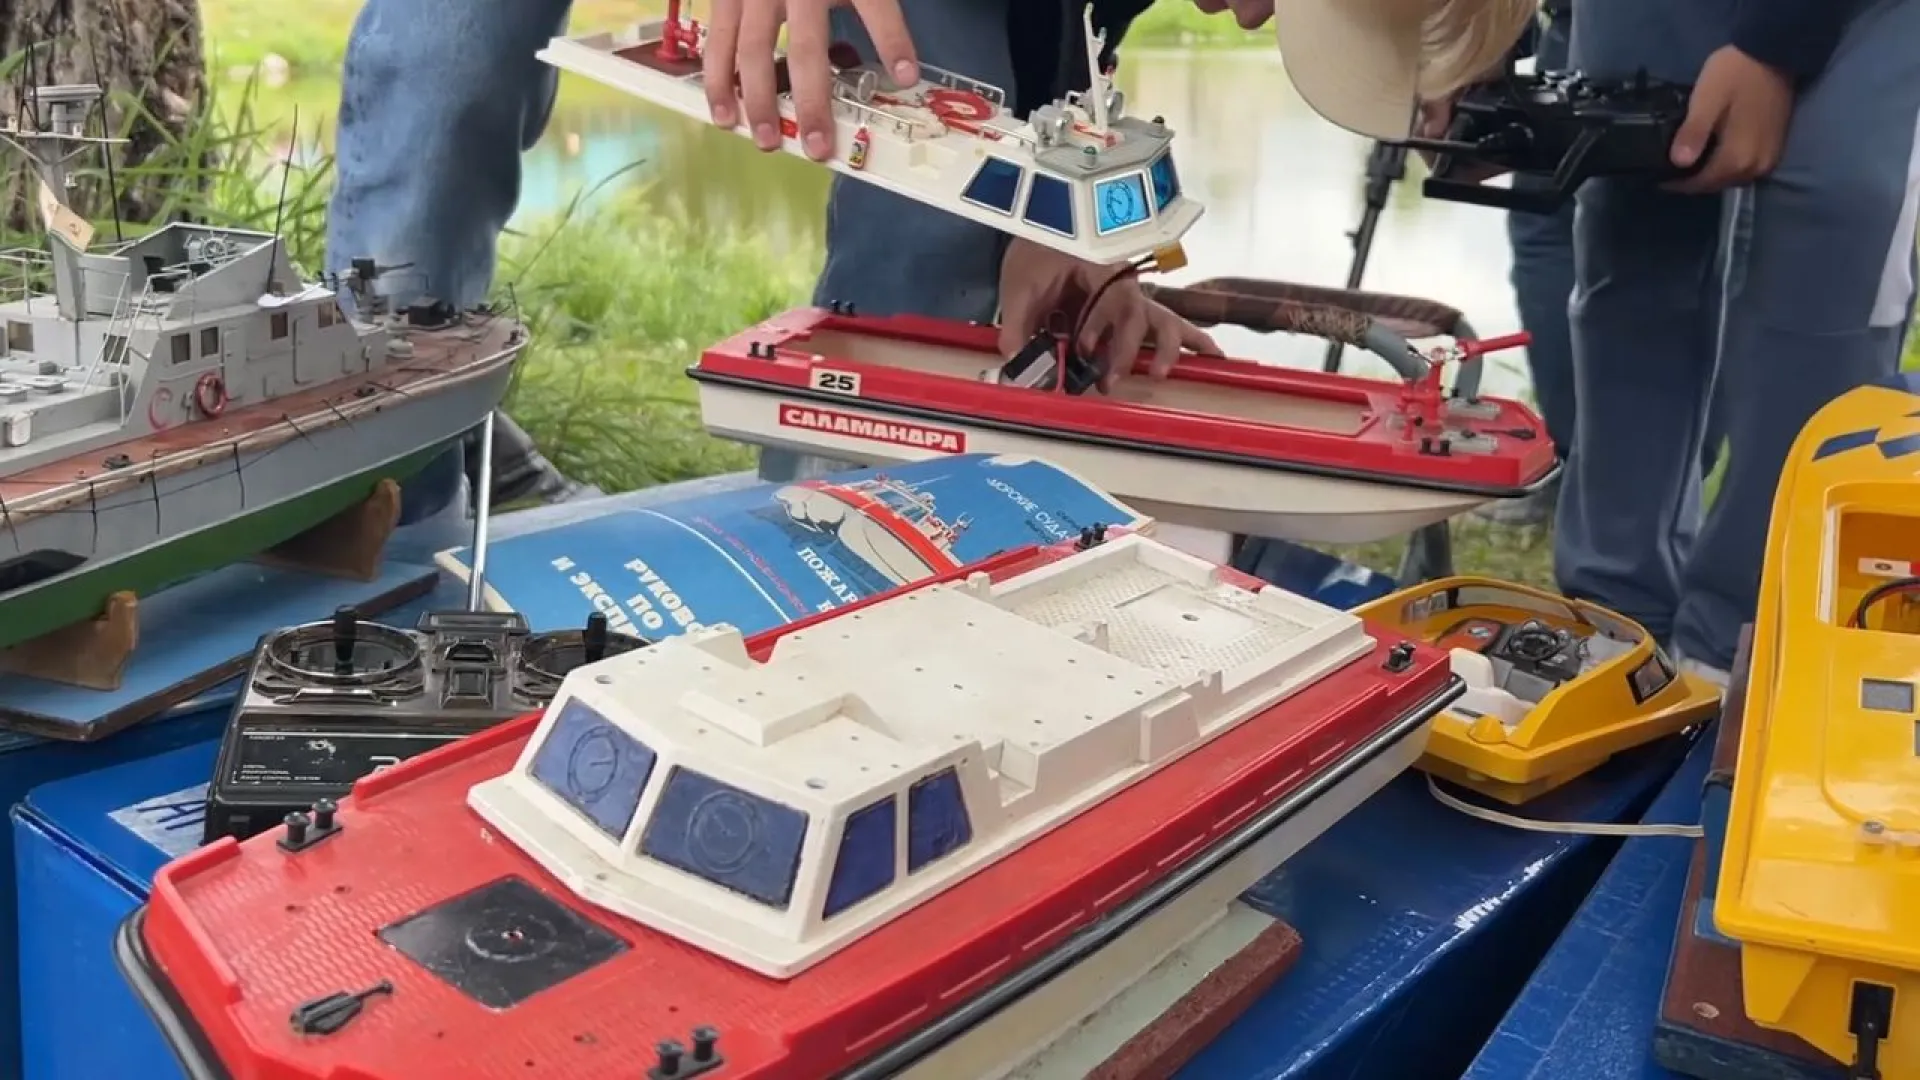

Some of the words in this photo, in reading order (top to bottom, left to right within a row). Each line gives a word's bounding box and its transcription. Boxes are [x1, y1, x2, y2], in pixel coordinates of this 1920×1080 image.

[818, 372, 855, 392] 25
[784, 407, 959, 451] САЛАМАНДРА
[551, 555, 577, 571] И
[626, 593, 664, 630] ПО
